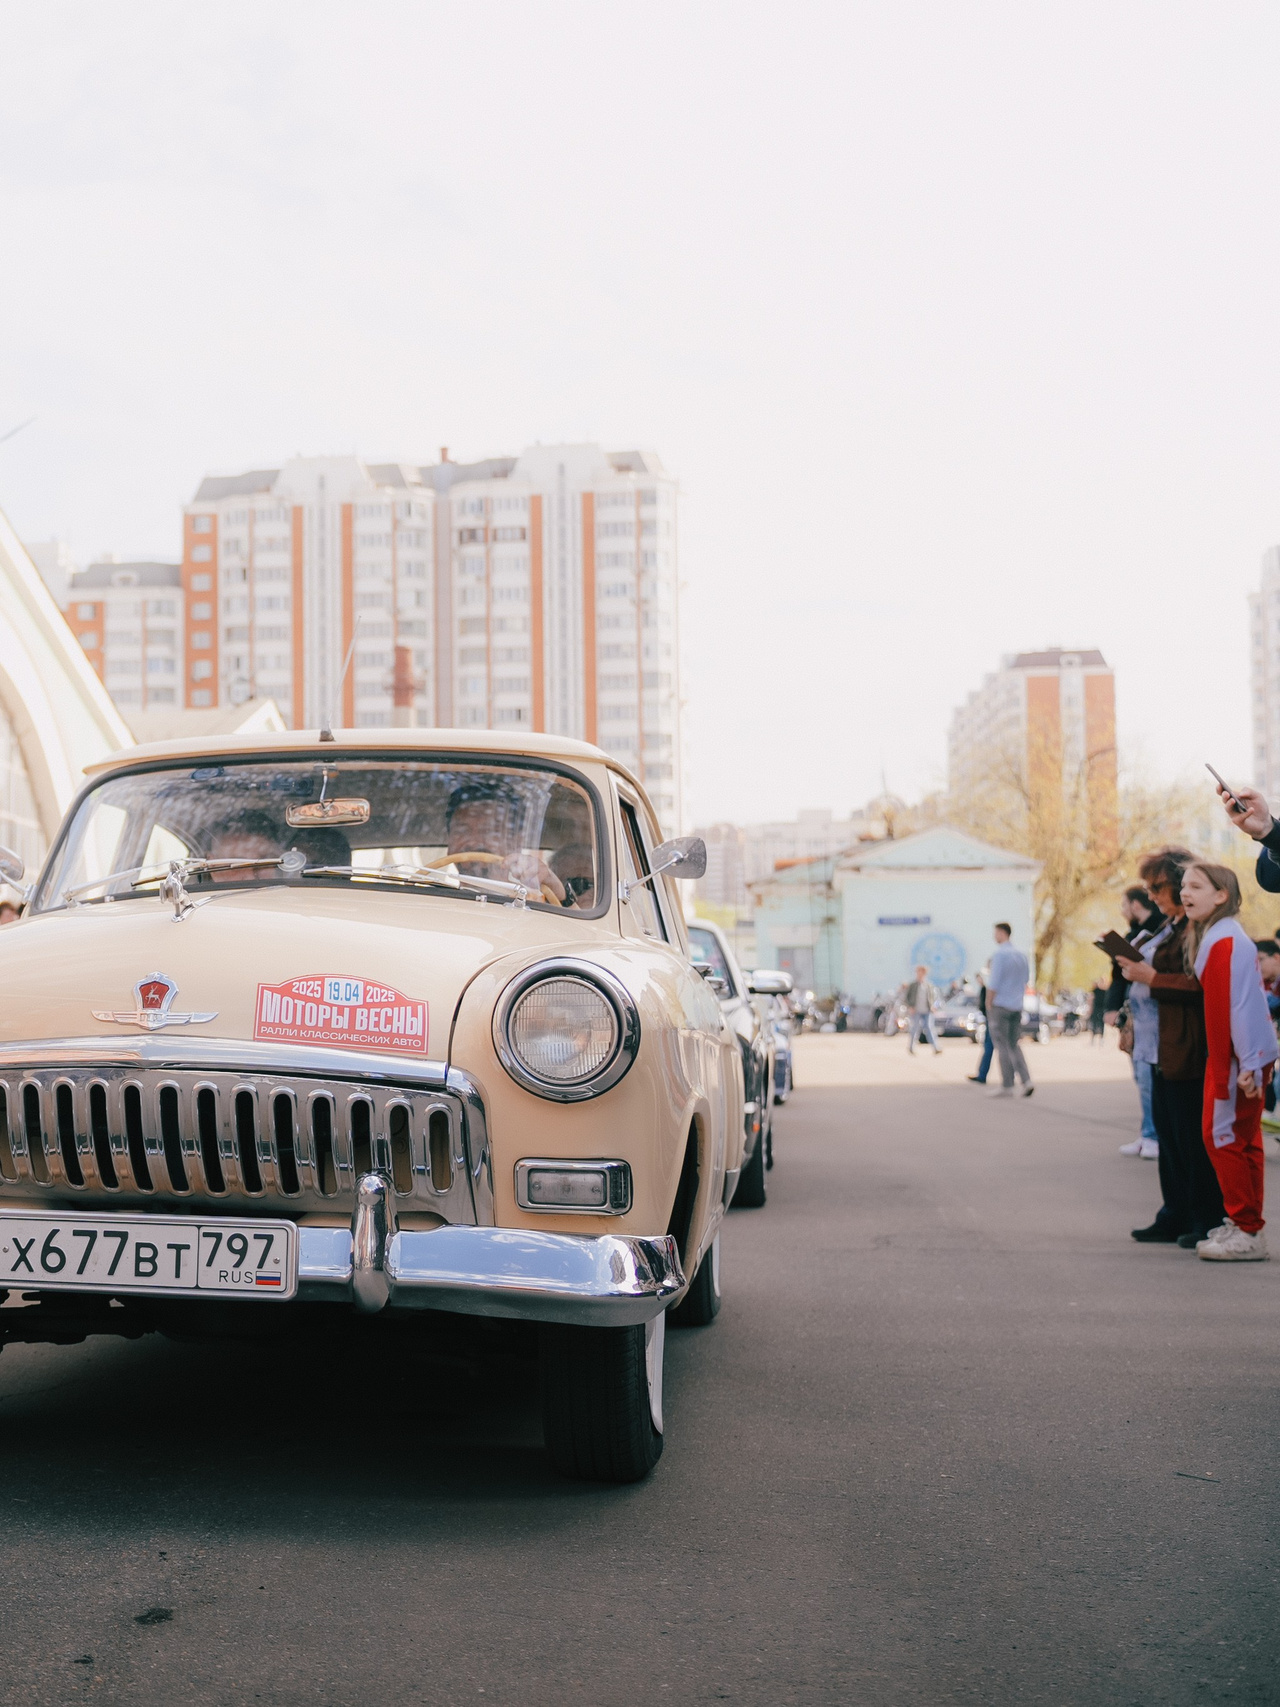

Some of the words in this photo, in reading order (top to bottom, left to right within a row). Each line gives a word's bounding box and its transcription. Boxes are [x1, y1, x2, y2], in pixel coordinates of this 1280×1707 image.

[292, 981, 321, 998] 2025
[328, 982, 359, 1001] 19.04
[366, 985, 395, 1002] 2025
[261, 989, 350, 1029] МОТОРЫ
[355, 1005, 423, 1036] ВЕСНЫ
[261, 1026, 297, 1037] РАЛЛИ
[300, 1030, 390, 1045] КЛАССИЧЕСКИХ
[392, 1038, 421, 1047] АВТО
[10, 1228, 191, 1278] Х677ВТ
[202, 1232, 274, 1268] 797
[219, 1270, 253, 1284] RUS
